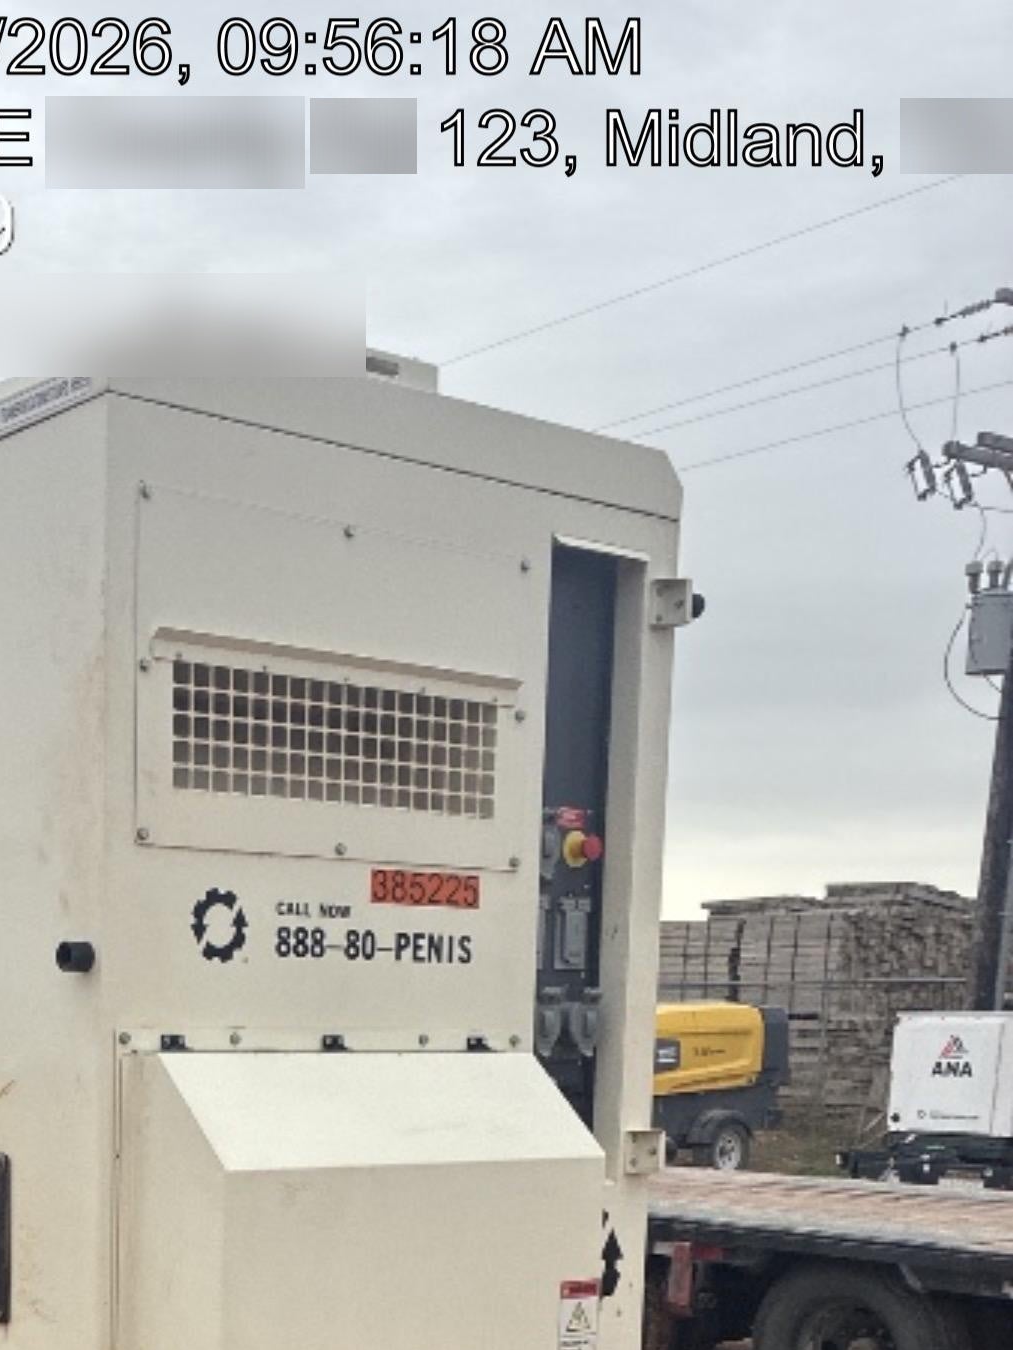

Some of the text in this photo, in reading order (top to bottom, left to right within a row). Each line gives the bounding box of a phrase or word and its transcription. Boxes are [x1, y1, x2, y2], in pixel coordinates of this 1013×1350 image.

[372, 871, 479, 907] 385225
[275, 902, 351, 918] CALL NOW
[931, 1061, 972, 1078] ANA
